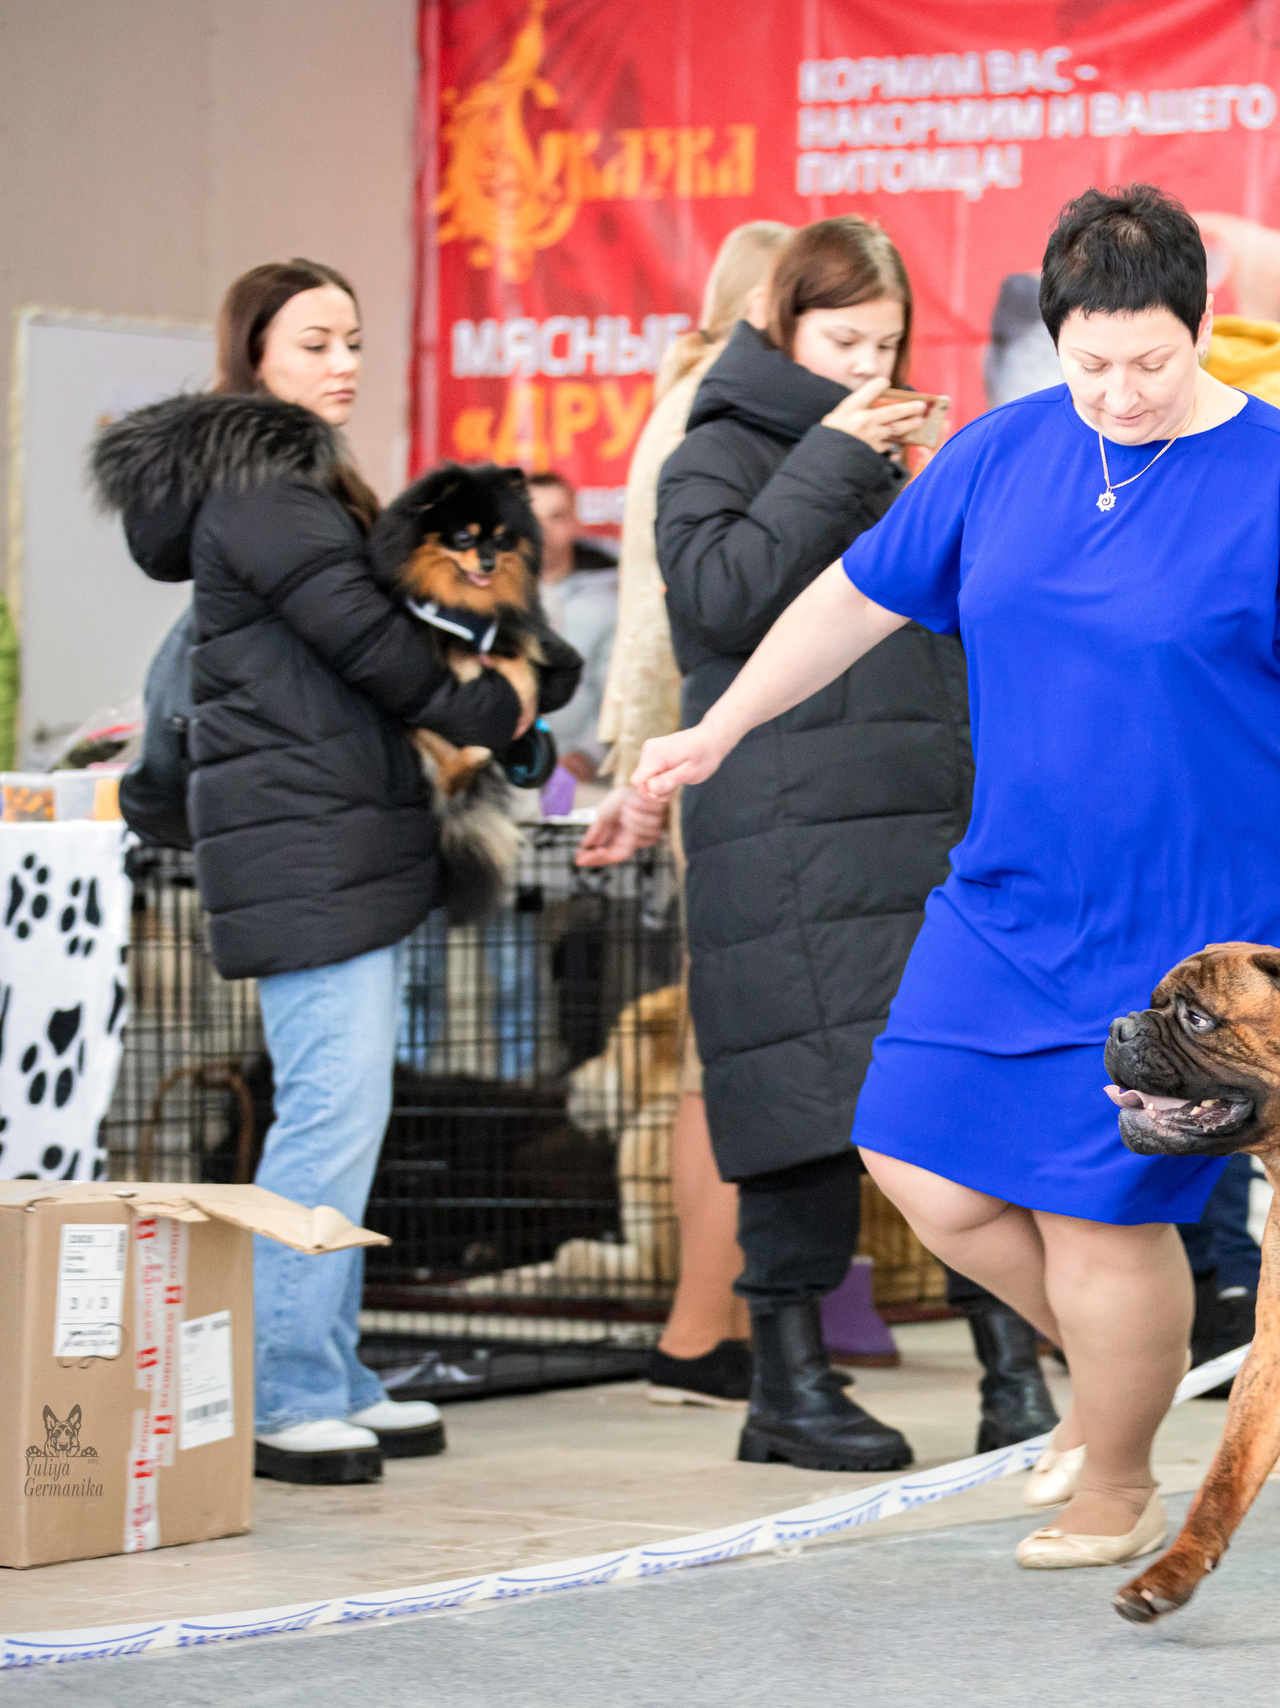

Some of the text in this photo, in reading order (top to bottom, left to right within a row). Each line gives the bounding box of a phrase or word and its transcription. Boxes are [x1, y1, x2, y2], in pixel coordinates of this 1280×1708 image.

[799, 52, 983, 102] КОРМИМ
[986, 46, 1073, 95] ВАС
[798, 81, 1278, 148] НАКОРМИМ И ВАШЕГО
[796, 144, 1022, 200] ПИТОМЦА!
